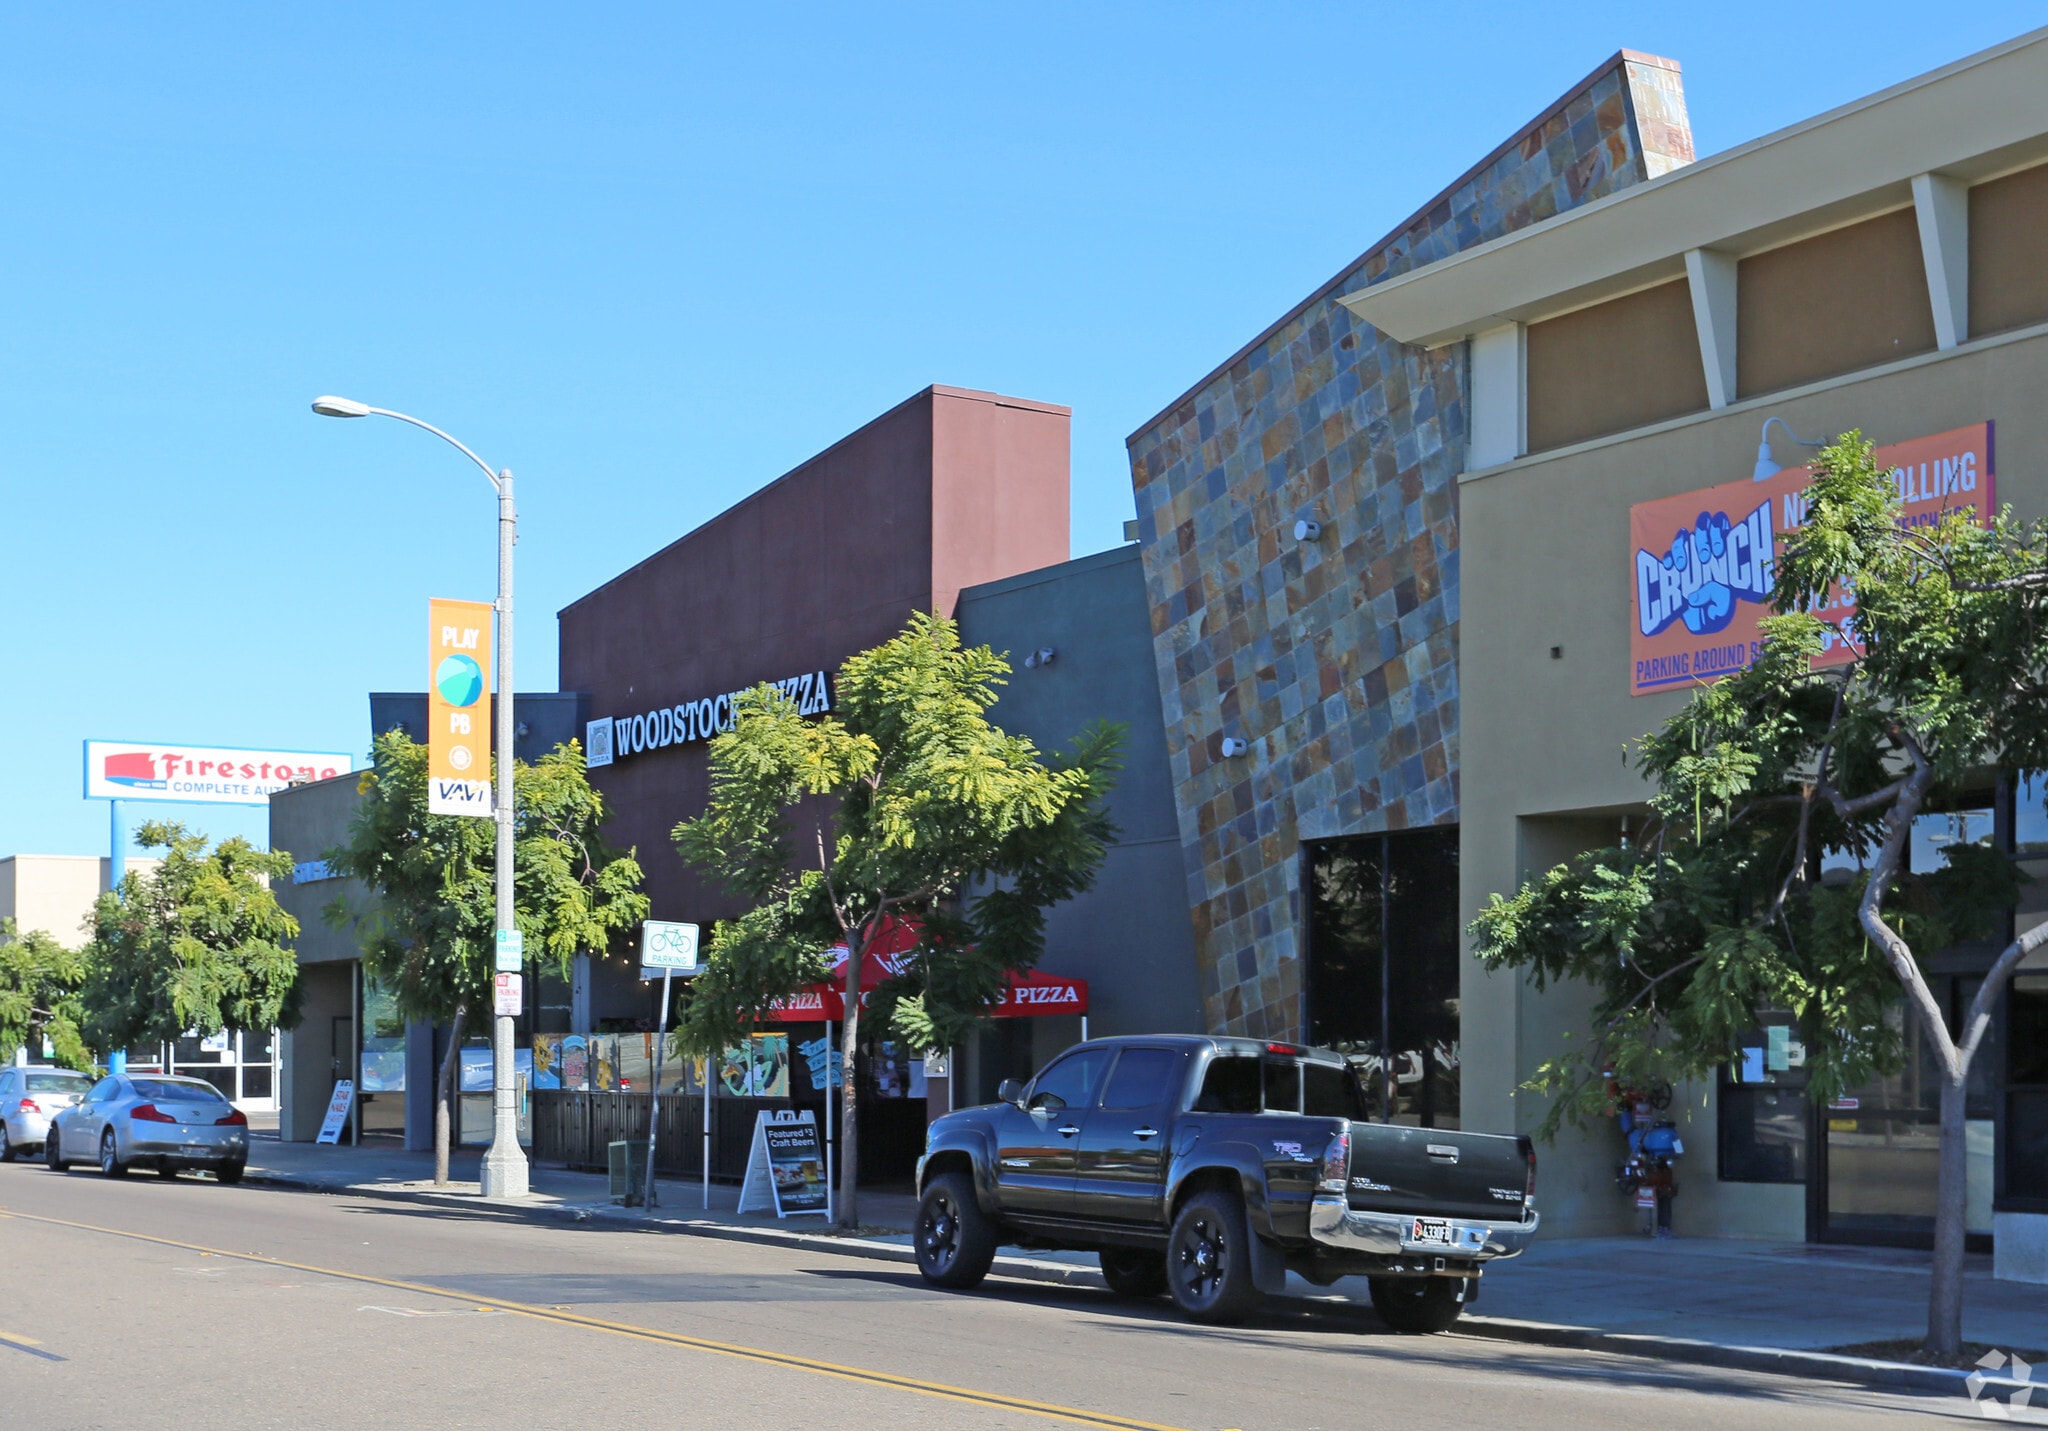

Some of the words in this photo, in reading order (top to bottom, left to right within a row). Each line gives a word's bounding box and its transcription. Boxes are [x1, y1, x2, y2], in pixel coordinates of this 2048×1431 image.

[1636, 499, 1776, 636] CRUNCH
[442, 626, 480, 649] PLAY
[1636, 652, 1690, 681] PARKING
[1693, 643, 1746, 672] AROUND
[450, 712, 471, 735] PB
[161, 754, 338, 782] Firestone
[173, 782, 250, 795] COMPLETE
[652, 955, 687, 965] PARKING
[788, 993, 824, 1009] PIZZA
[1014, 986, 1079, 1004] PIZZA
[768, 1129, 804, 1138] Featured
[805, 1128, 814, 1137] $3
[771, 1139, 791, 1147] Craft
[792, 1138, 815, 1146] Beers
